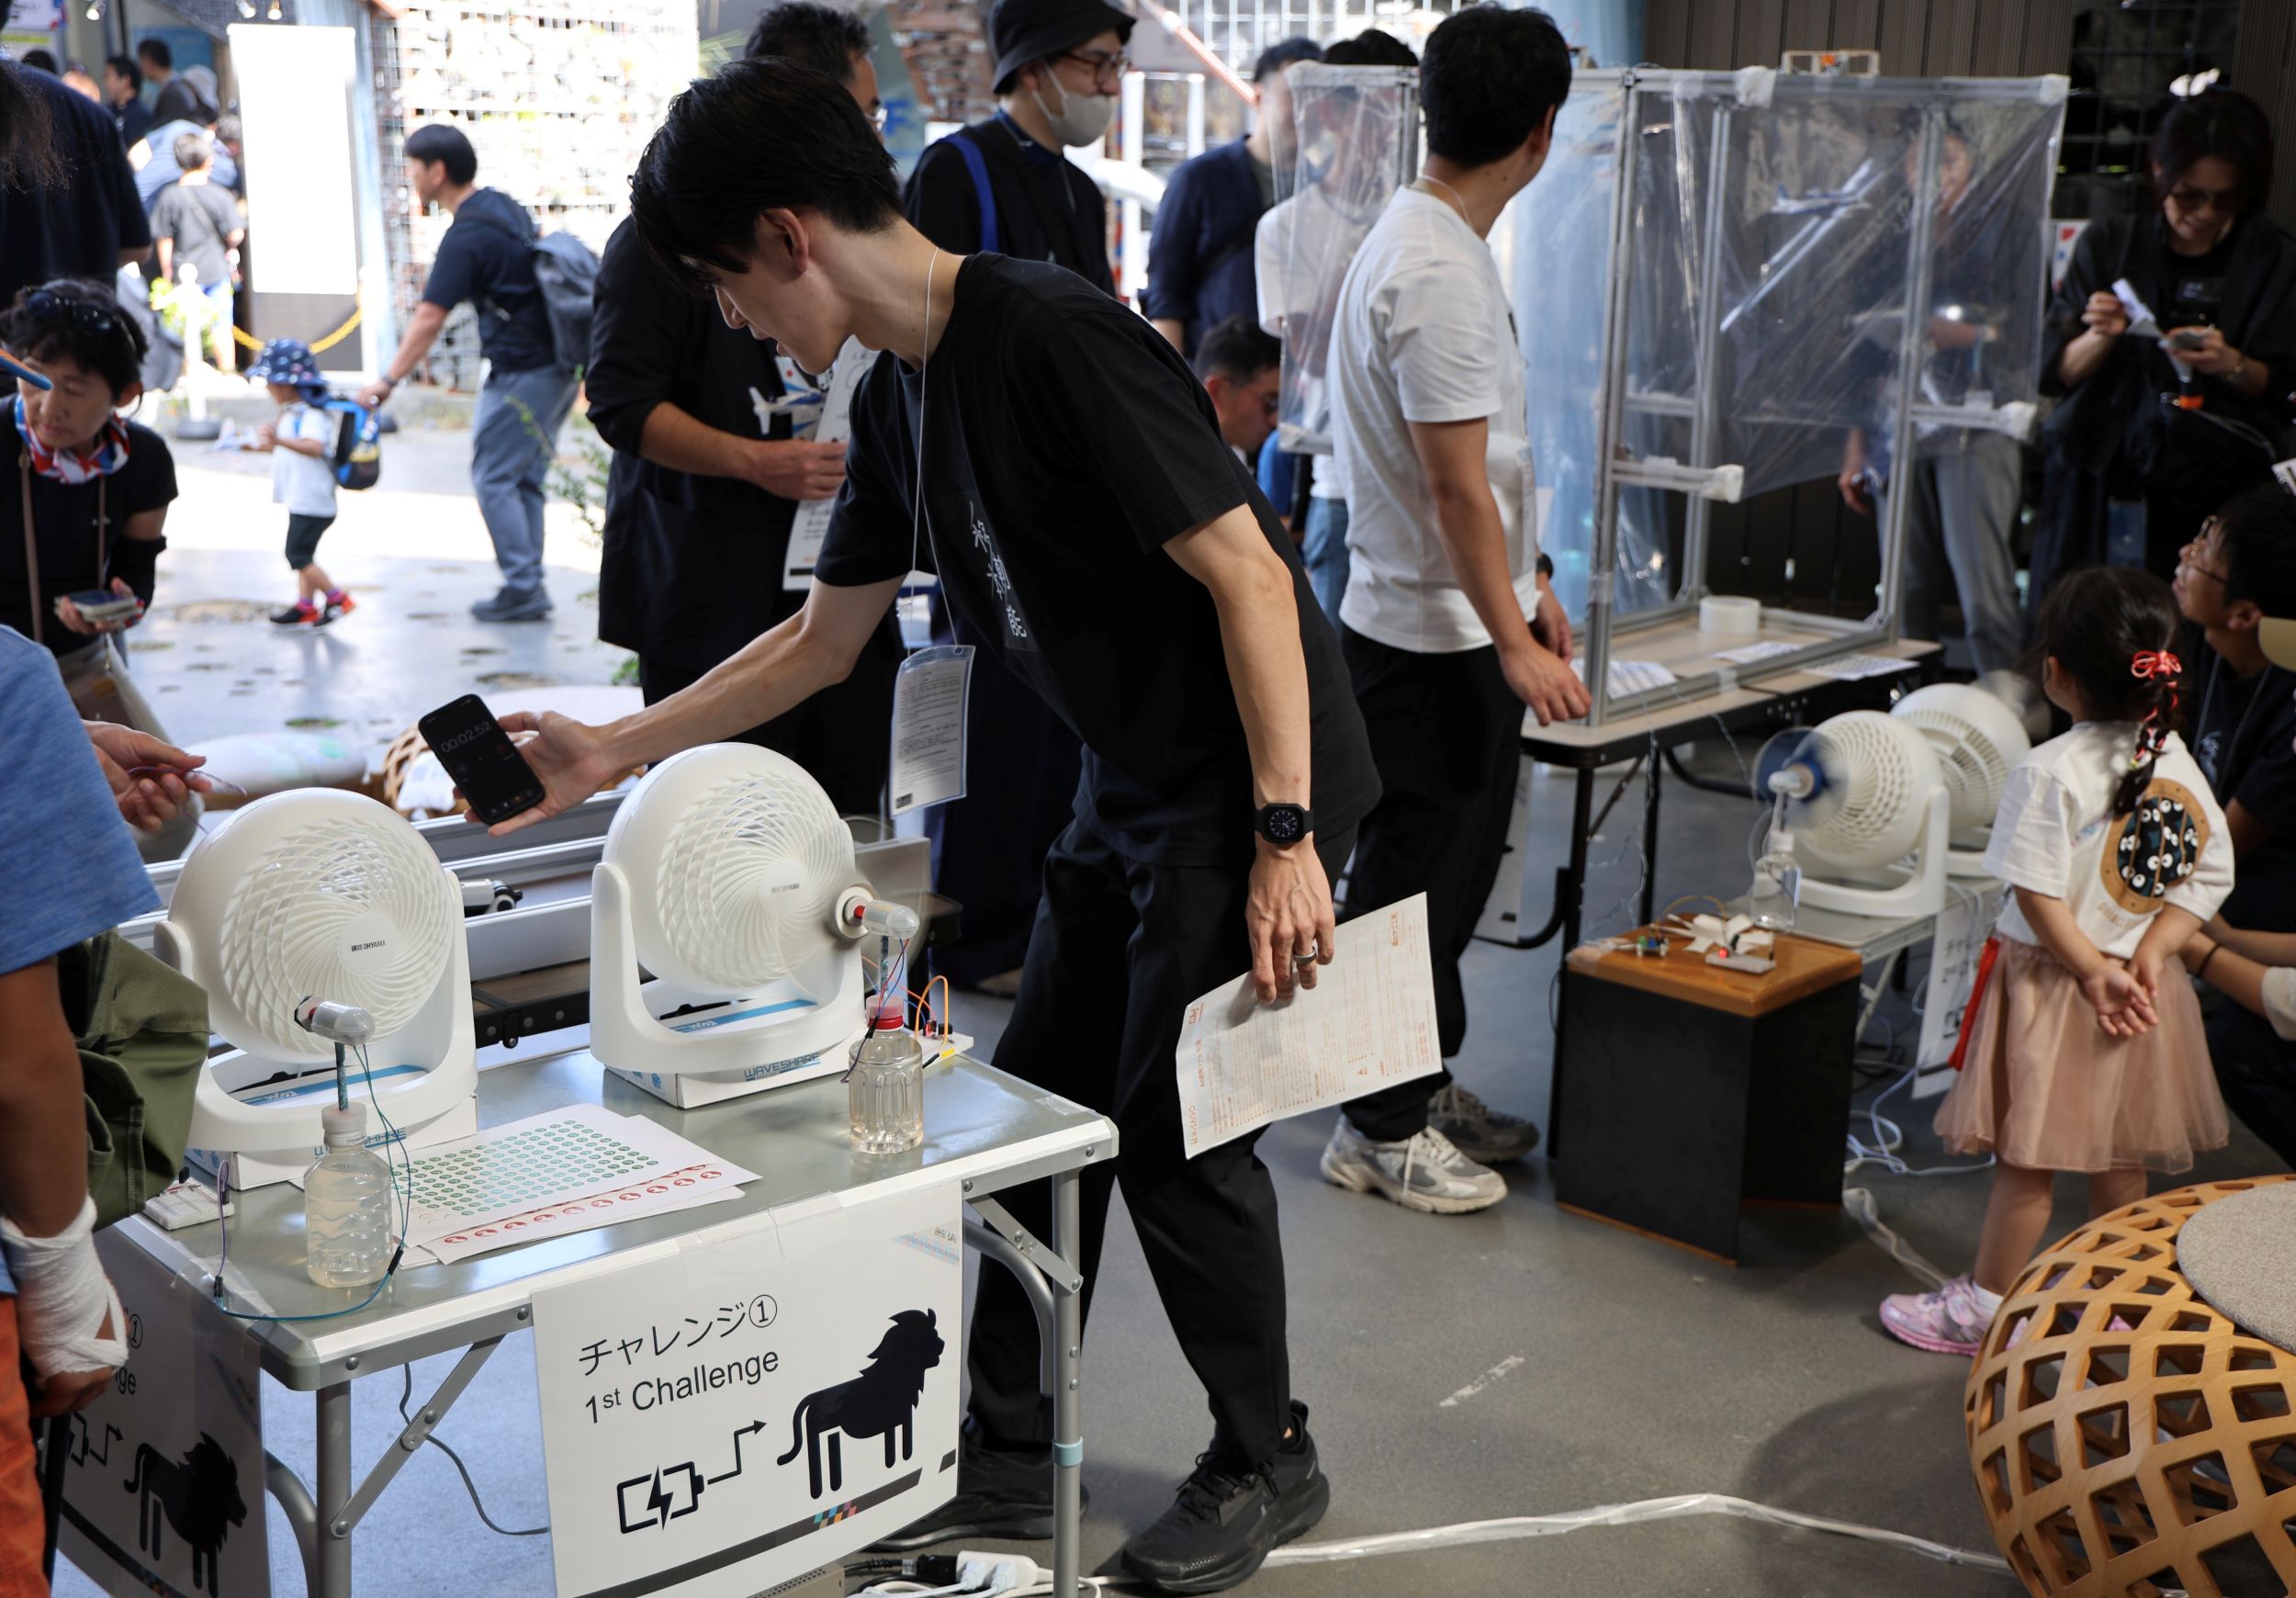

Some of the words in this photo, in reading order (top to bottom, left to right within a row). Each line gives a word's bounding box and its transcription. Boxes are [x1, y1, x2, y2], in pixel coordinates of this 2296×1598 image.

[351, 944, 363, 952] IRIS
[364, 940, 387, 951] OHYAMA
[744, 1052, 820, 1079] WAVESHARE
[579, 1294, 778, 1377] チャレンジ①
[585, 1388, 622, 1424] 1st
[632, 1351, 779, 1411] Challenge
